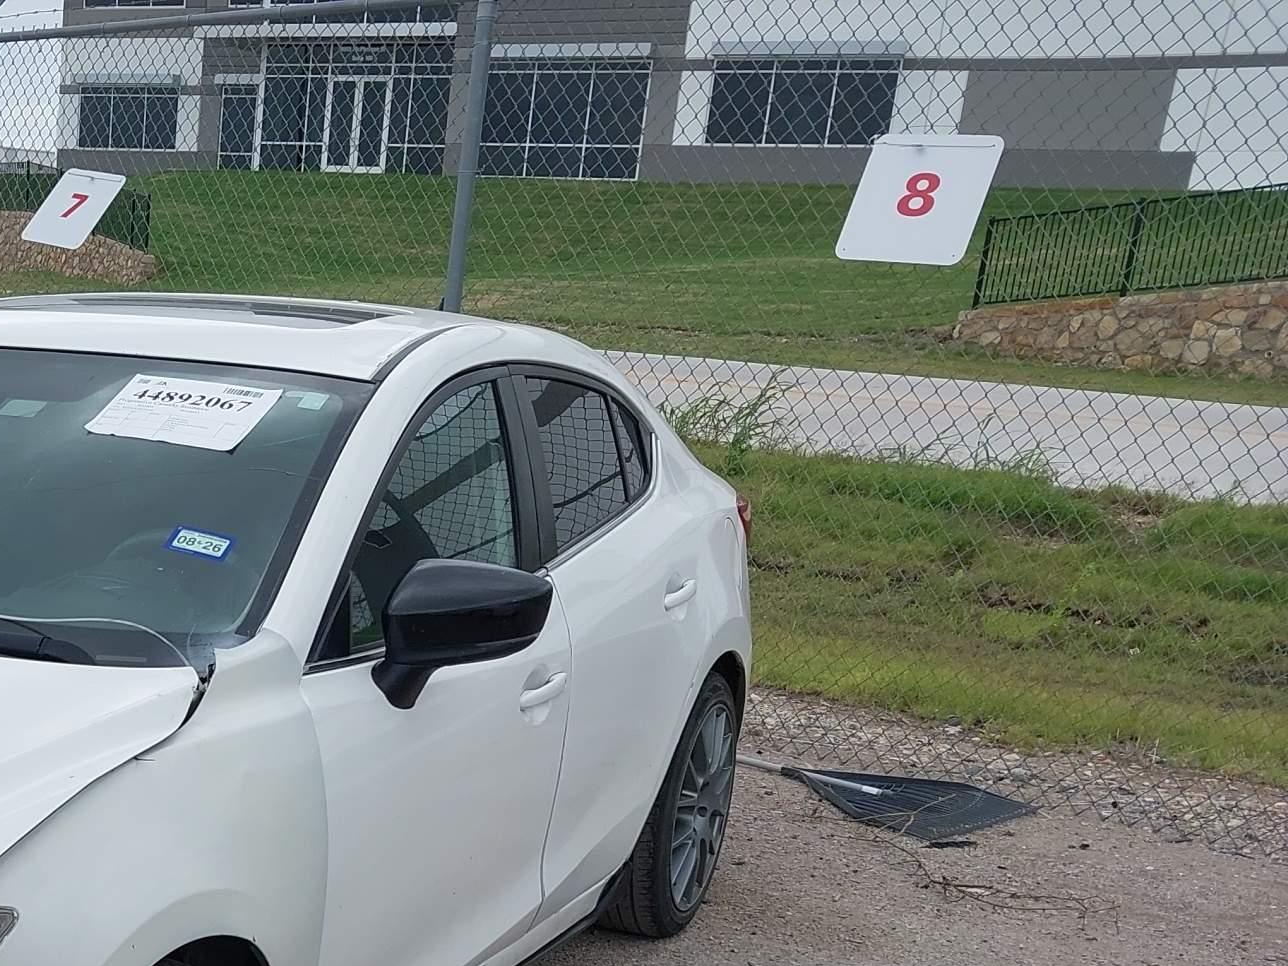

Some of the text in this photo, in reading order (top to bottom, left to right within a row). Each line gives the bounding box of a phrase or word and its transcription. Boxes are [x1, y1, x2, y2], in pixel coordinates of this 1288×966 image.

[59, 193, 89, 219] 7
[896, 172, 941, 217] 8
[133, 389, 253, 413] 44892067
